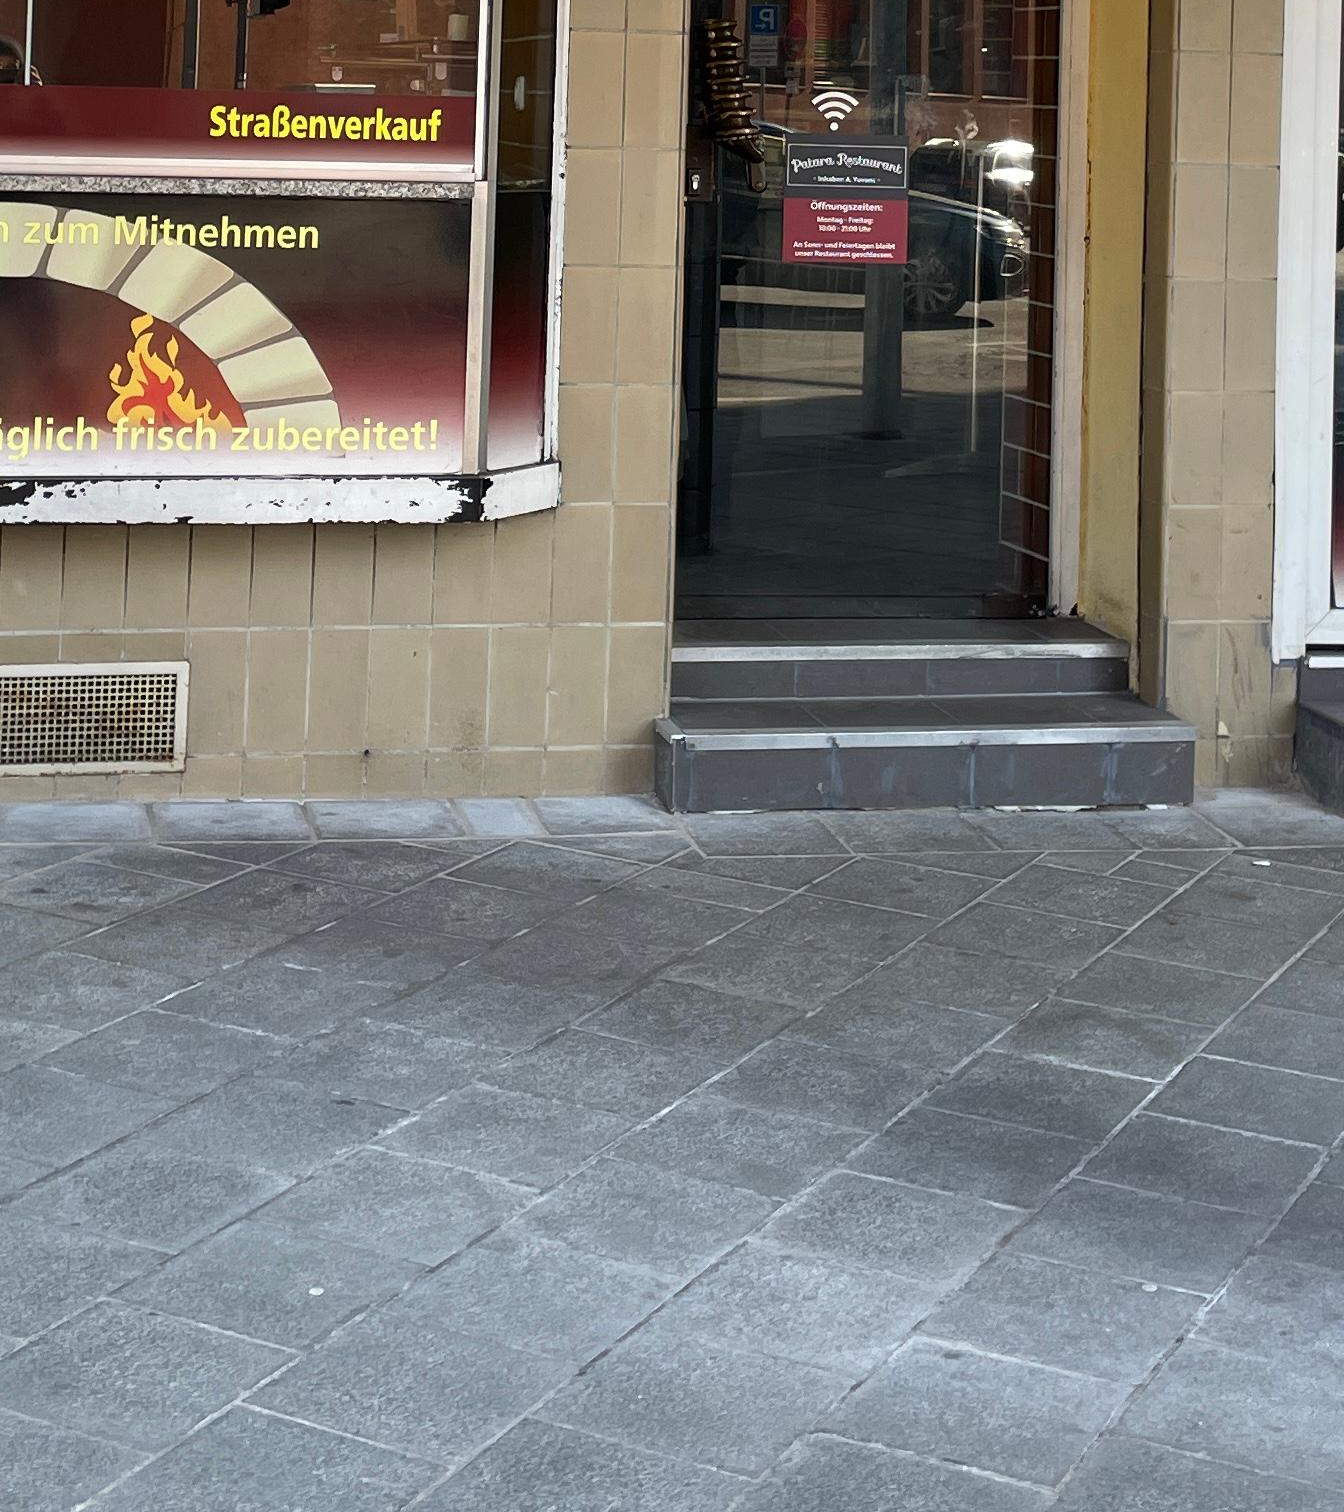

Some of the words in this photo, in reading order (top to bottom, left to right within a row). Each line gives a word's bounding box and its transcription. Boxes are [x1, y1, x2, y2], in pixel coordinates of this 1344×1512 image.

[209, 104, 443, 142] Straßenverkauf
[790, 156, 835, 174] Patara
[836, 152, 904, 175] Restaurant
[810, 199, 884, 213] Öffnungszeiten:
[816, 215, 844, 224] Montag
[22, 217, 100, 247] zum
[114, 214, 320, 250] Mitnehmen
[111, 418, 222, 454] frisch
[230, 418, 439, 454] zubereitet!
